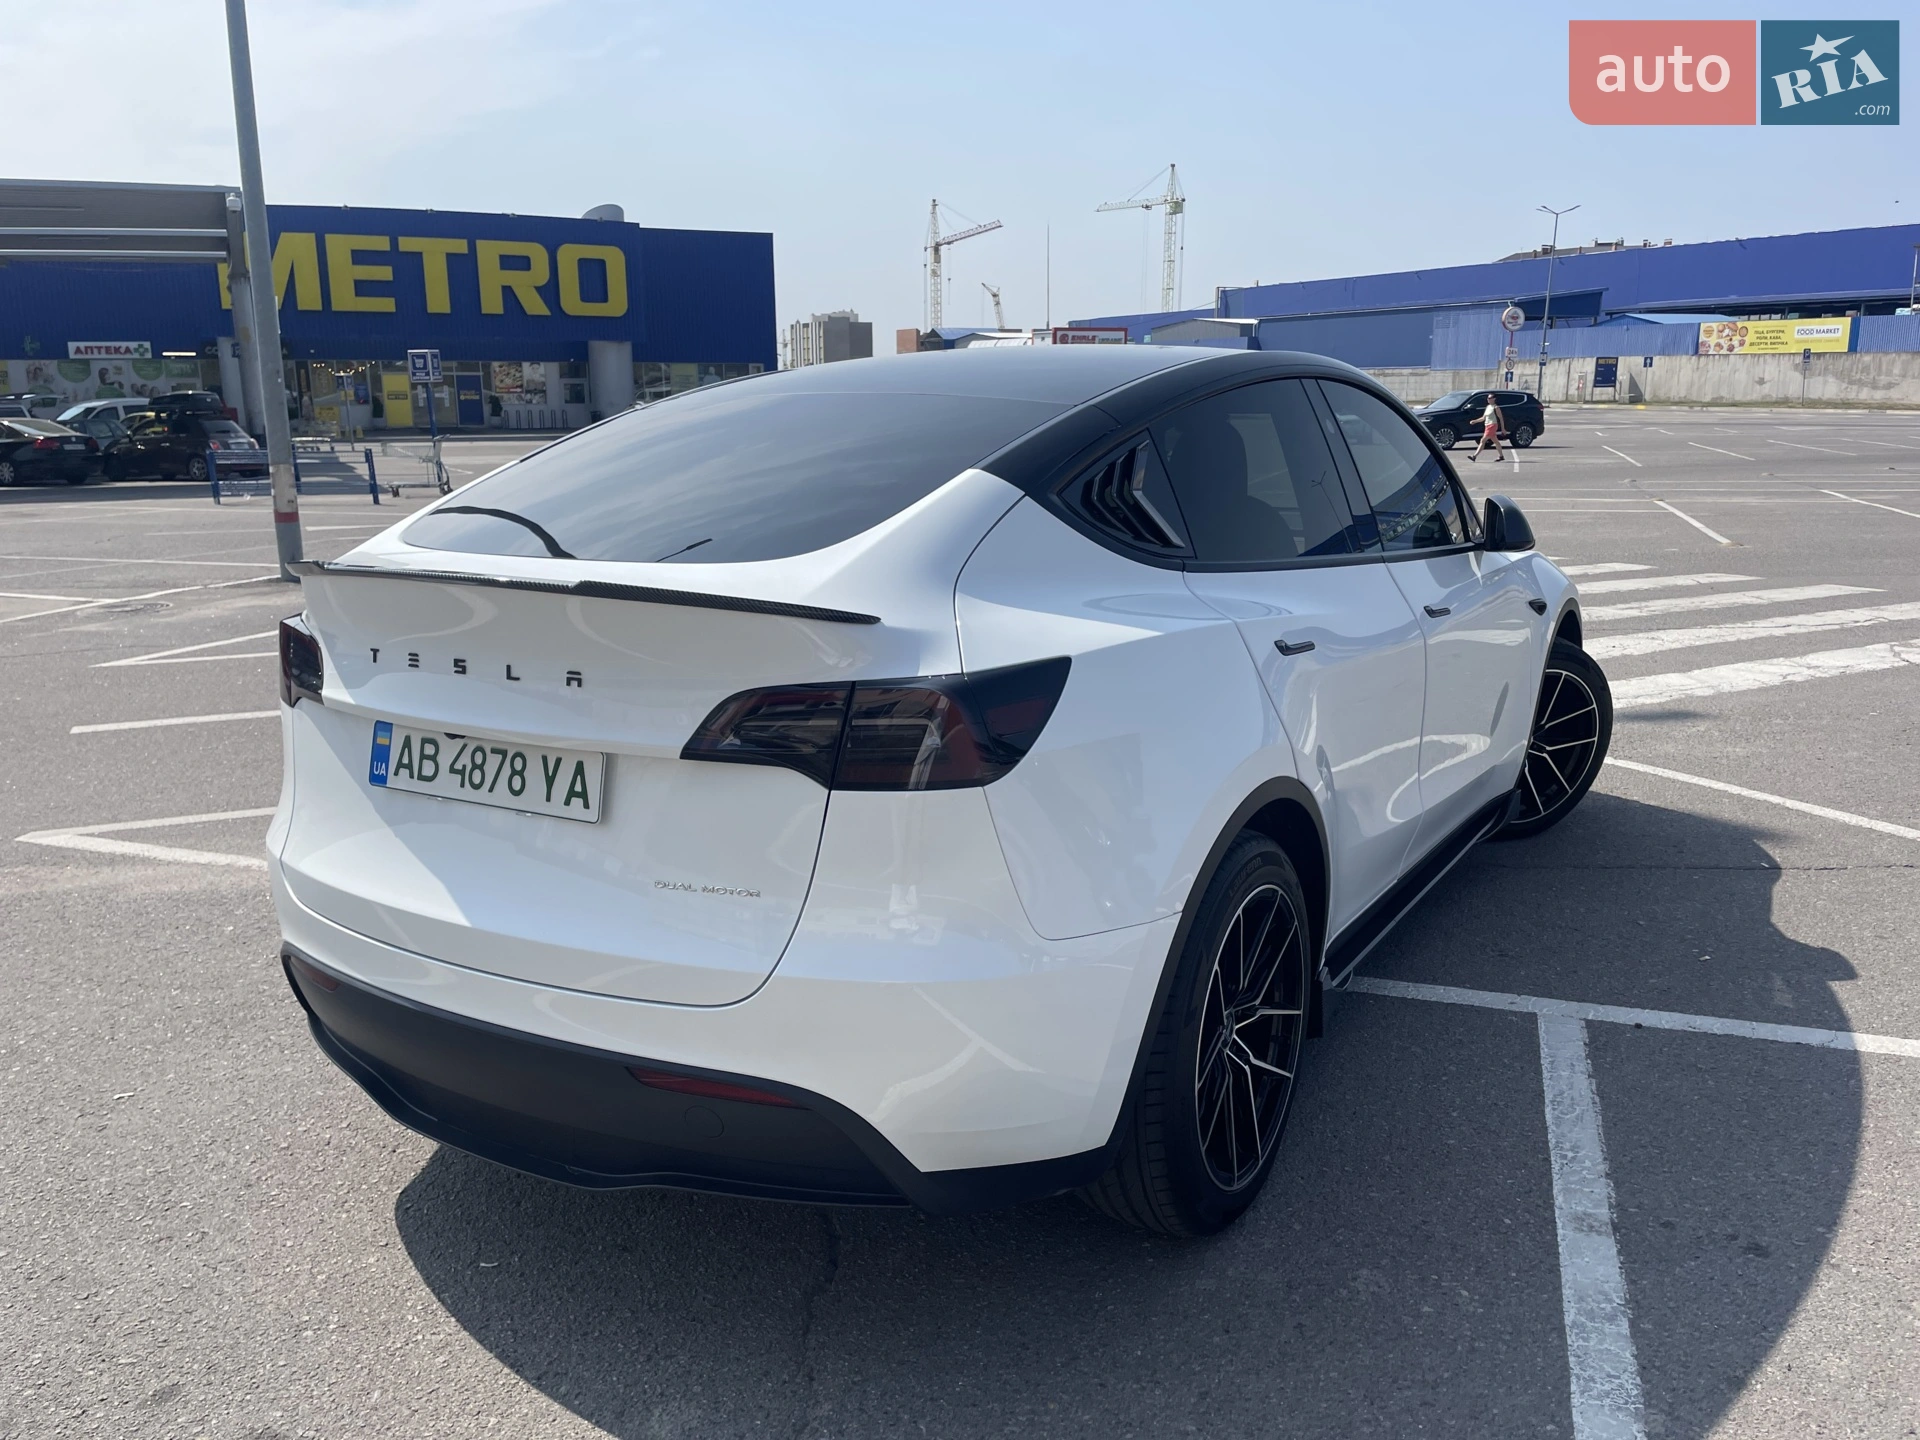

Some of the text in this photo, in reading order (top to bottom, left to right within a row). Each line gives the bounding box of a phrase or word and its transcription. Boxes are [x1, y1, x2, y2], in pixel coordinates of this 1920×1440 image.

[216, 231, 628, 318] METRO
[1796, 327, 1840, 336] FOOD MARKET
[73, 345, 134, 356] АПТЕКА
[370, 648, 582, 688] TESLA
[373, 762, 387, 776] UA
[393, 734, 590, 810] AB 4878 YA
[654, 880, 761, 897] DUAL MOTOR
